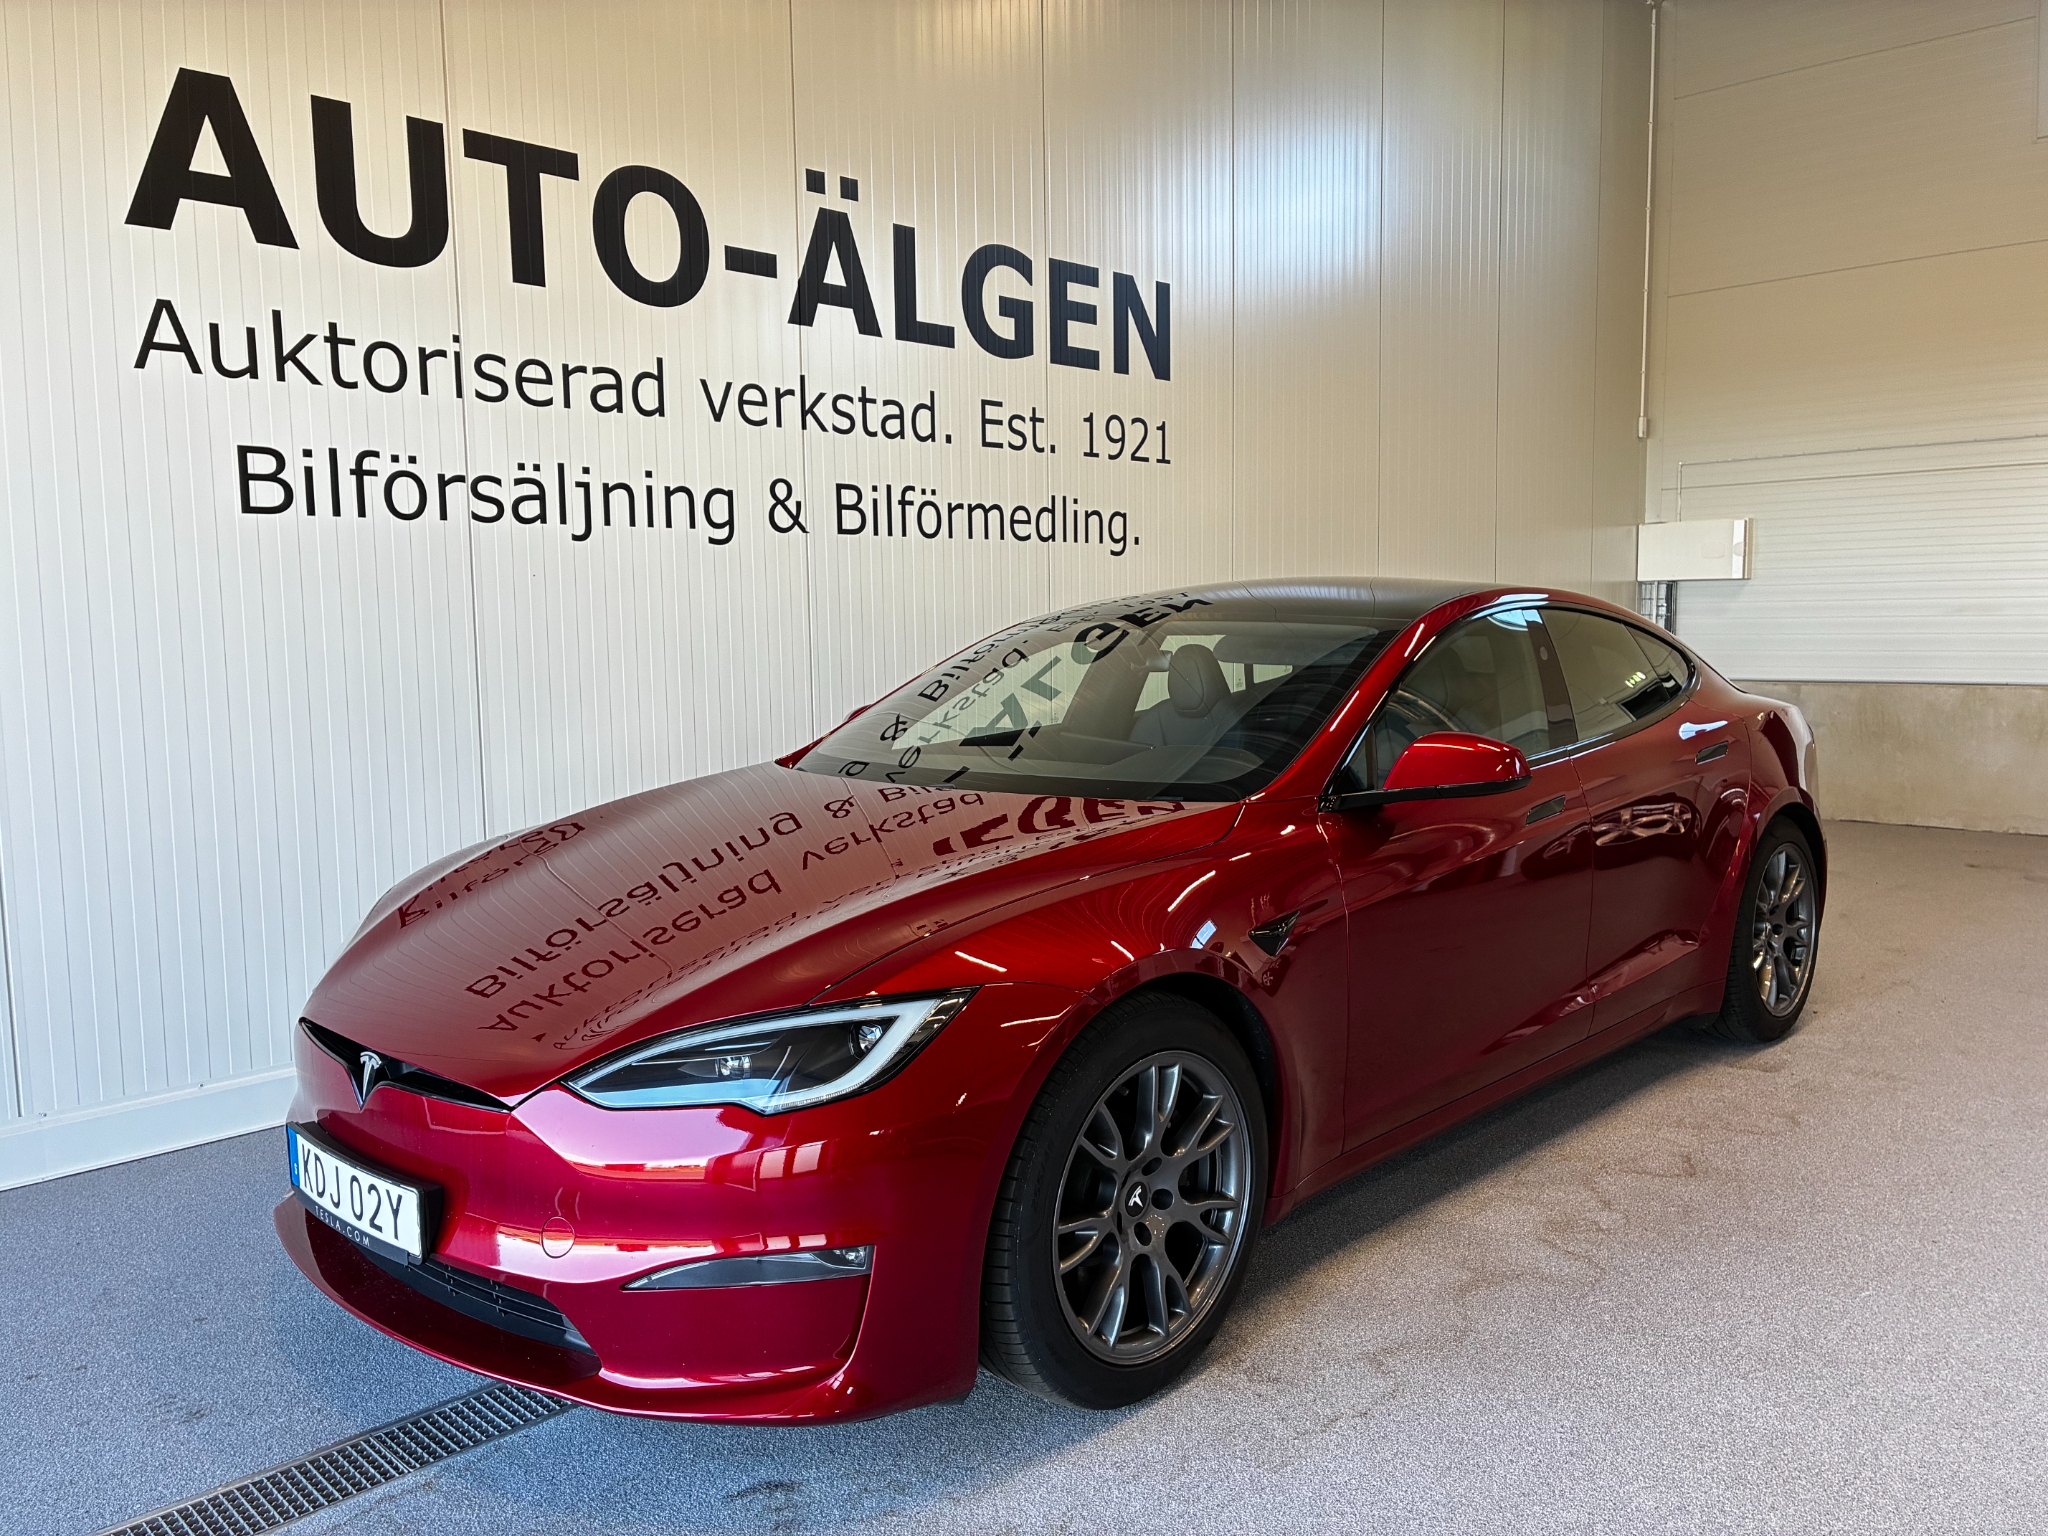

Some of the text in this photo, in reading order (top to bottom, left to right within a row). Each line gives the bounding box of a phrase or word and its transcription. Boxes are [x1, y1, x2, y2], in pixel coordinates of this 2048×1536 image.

[124, 67, 1171, 382] AUTO-ÄLGEN
[133, 298, 1172, 466] Auktoriserad verkstad. Est. 1921
[237, 445, 1141, 557] Bilförsäljning & Bilförmedling.
[302, 1144, 403, 1241] KDJ 02Y
[315, 1205, 370, 1247] TESLA.COM
